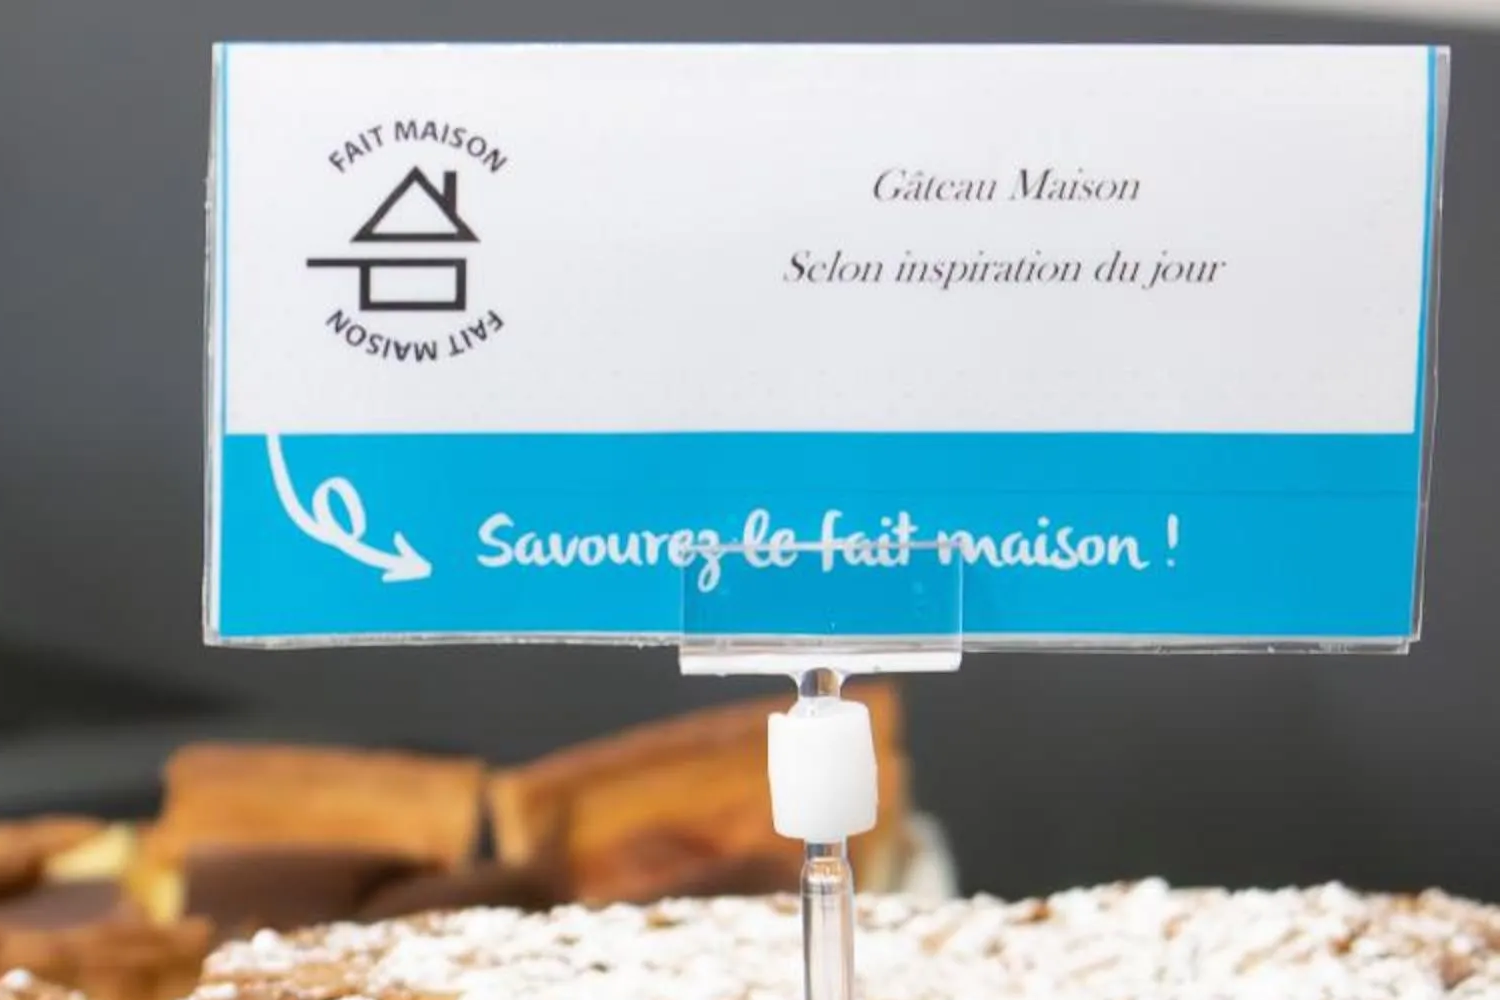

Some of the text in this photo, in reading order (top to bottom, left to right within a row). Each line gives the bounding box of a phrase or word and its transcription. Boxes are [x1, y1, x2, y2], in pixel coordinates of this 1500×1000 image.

[327, 120, 508, 174] FAIT MAISON
[873, 167, 1141, 201] Gâteau Maison
[782, 249, 1227, 291] Selon inspiration du jour
[325, 309, 505, 362] FAIT MAISON
[476, 512, 724, 592] Savourez
[742, 508, 800, 568] le
[818, 508, 920, 573] fait
[936, 515, 1151, 569] maison
